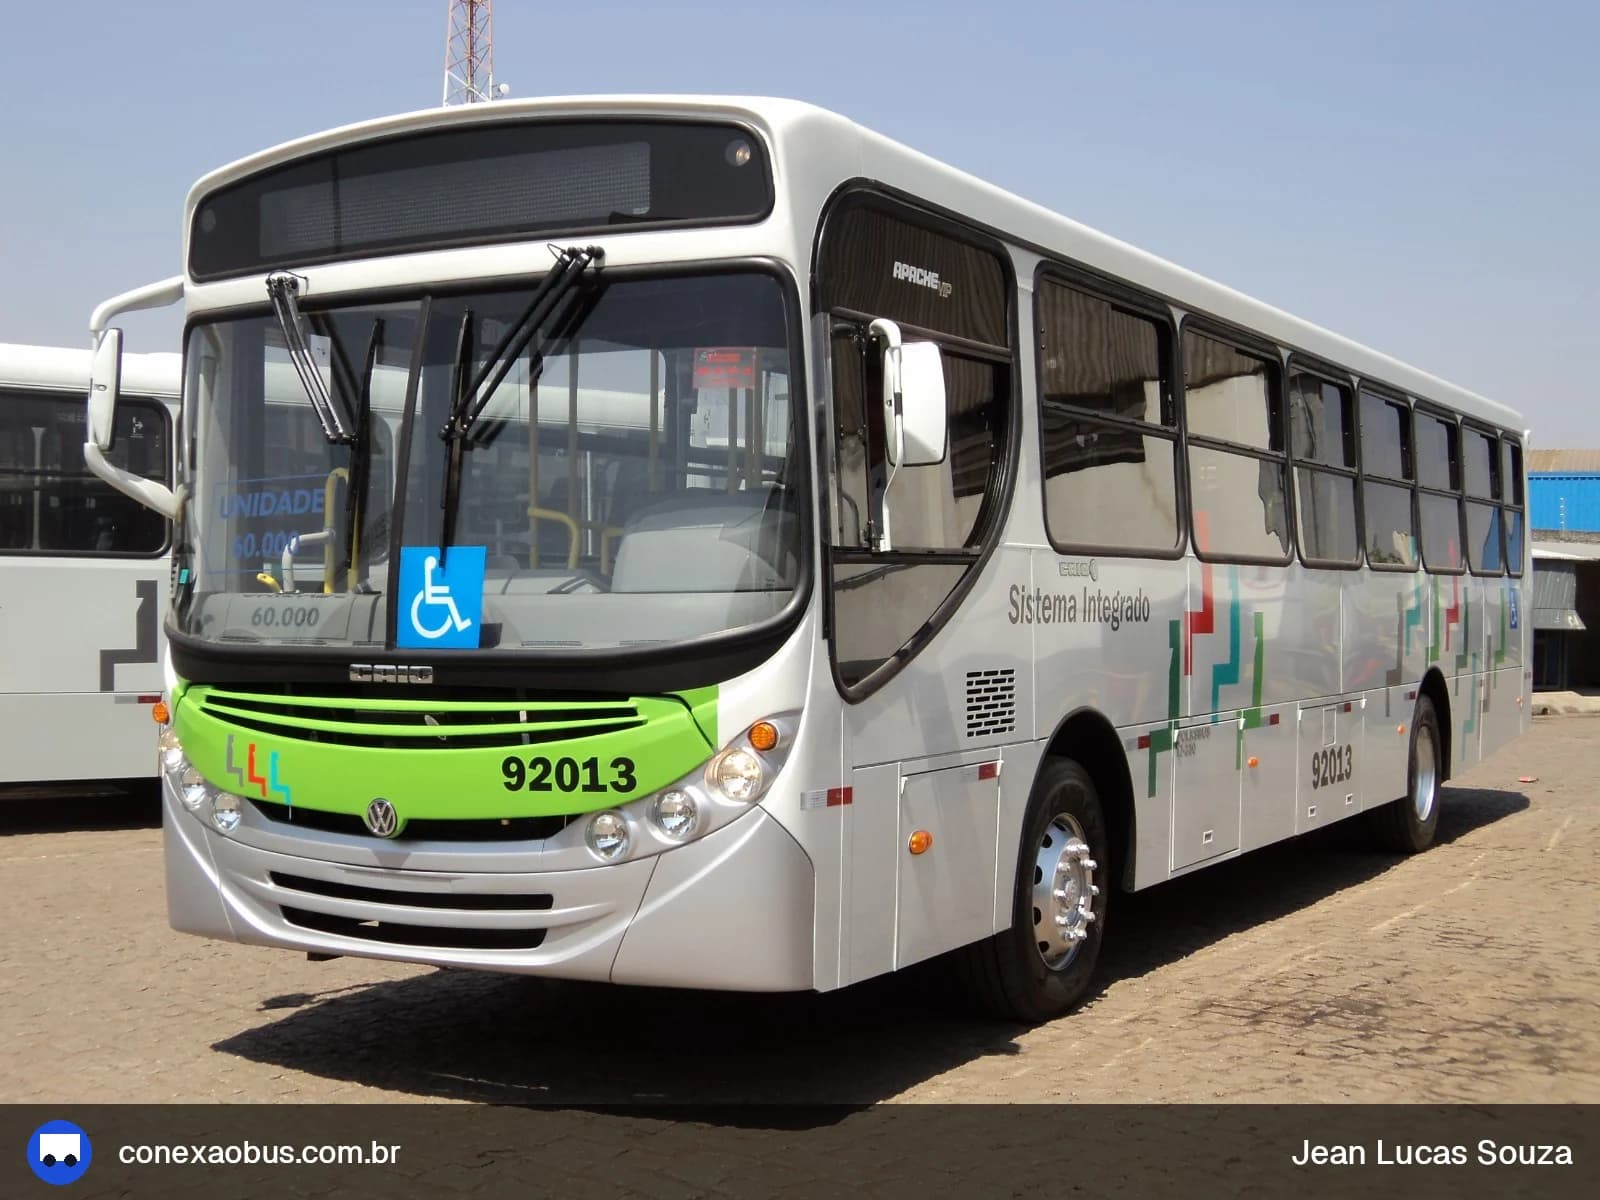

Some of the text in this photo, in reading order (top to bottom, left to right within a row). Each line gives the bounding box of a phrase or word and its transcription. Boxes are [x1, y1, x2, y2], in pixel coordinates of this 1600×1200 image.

[892, 261, 939, 290] APACHE
[219, 488, 326, 519] UNIDADE
[251, 606, 320, 627] 60.000
[1008, 584, 1150, 632] Sistema Integrado
[349, 663, 433, 684] CAIO
[501, 756, 637, 793] 92013
[1312, 744, 1352, 790] 92013
